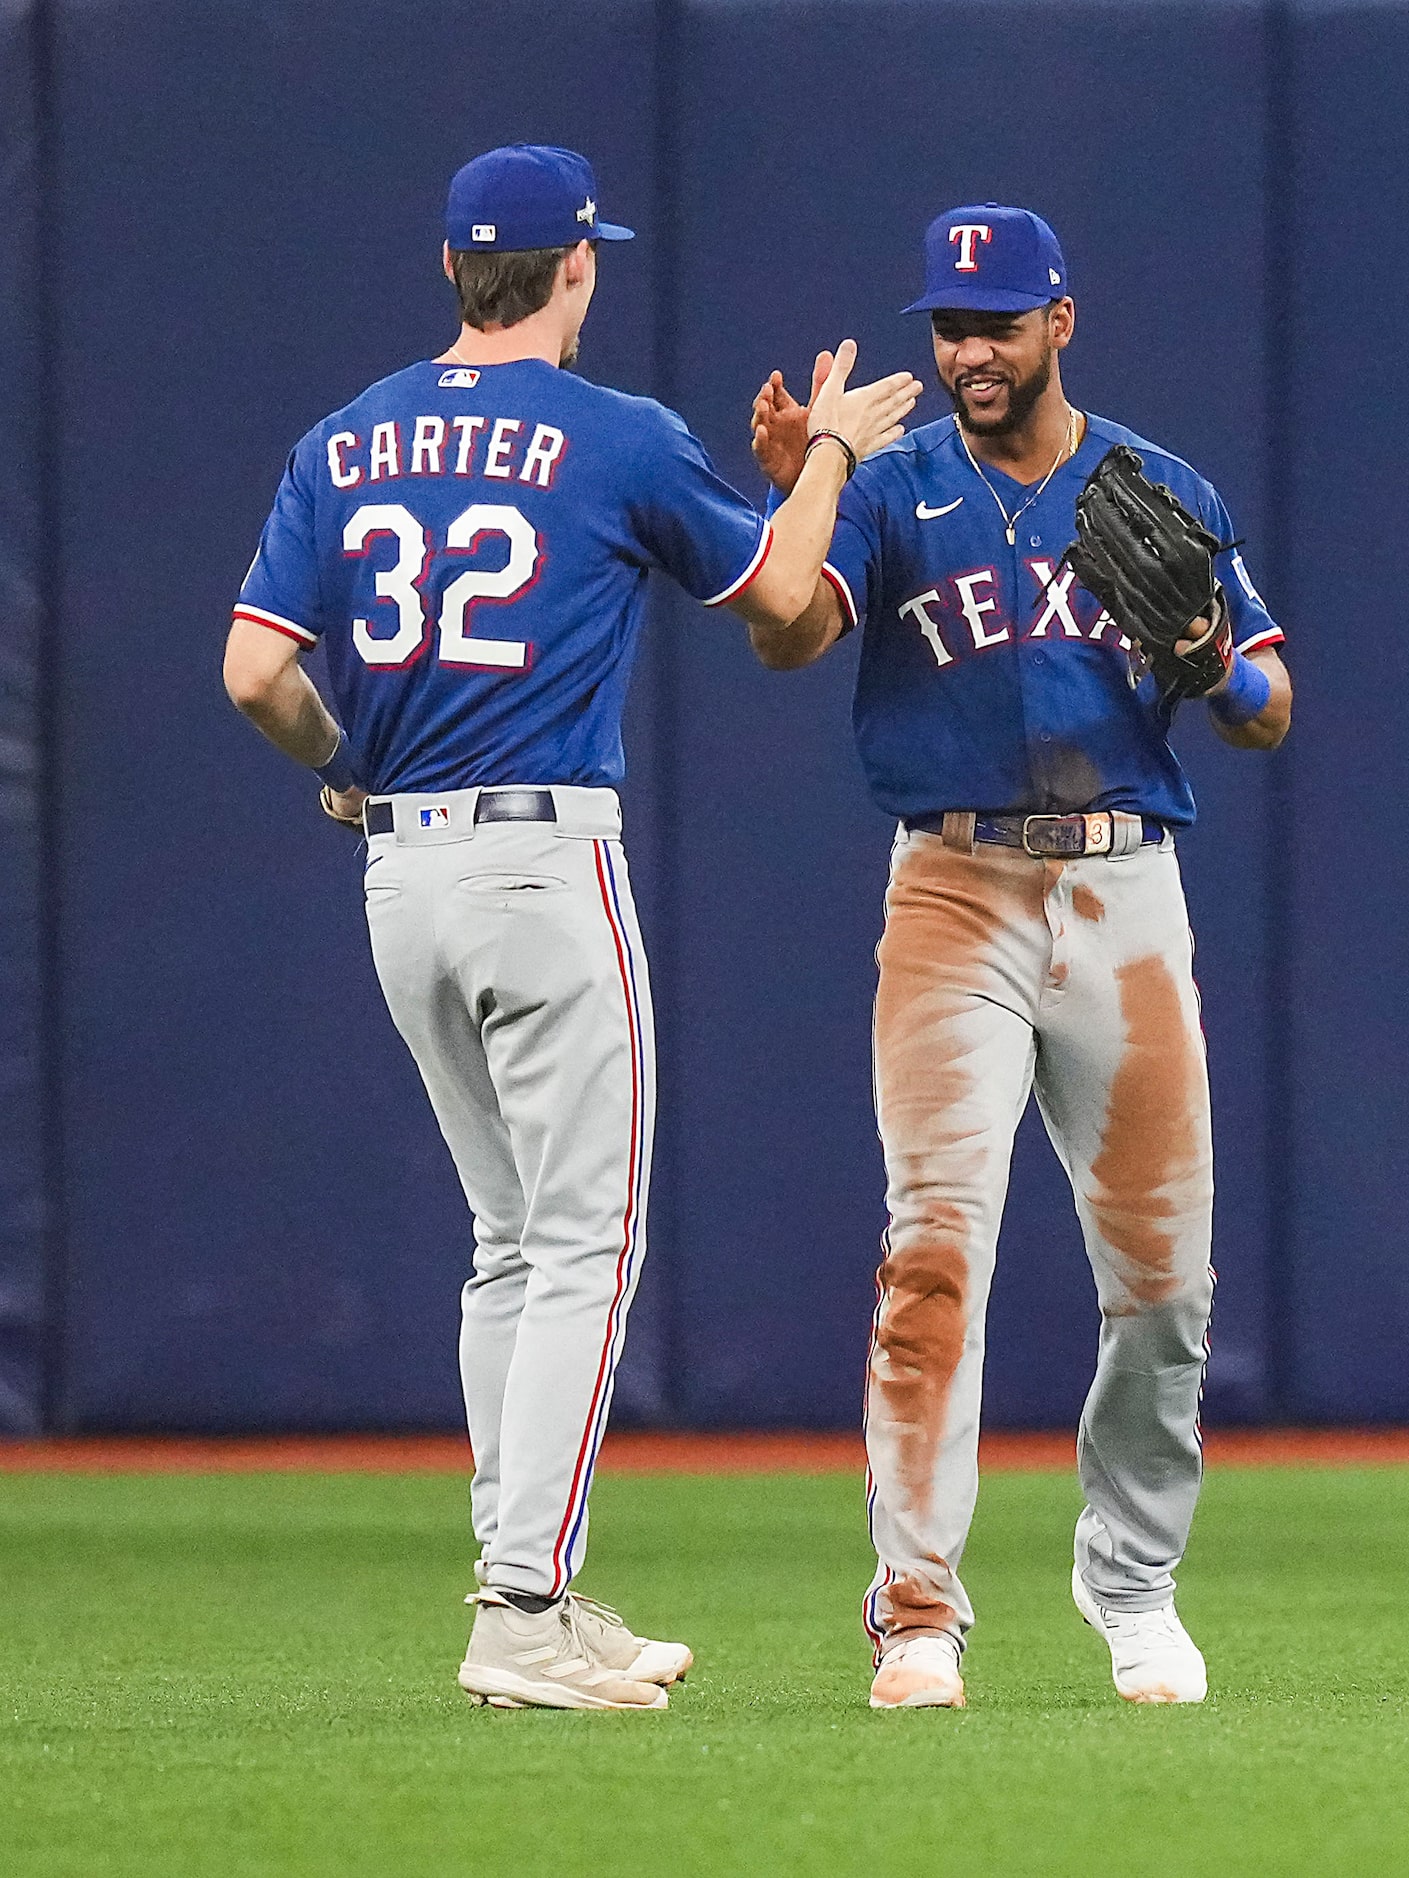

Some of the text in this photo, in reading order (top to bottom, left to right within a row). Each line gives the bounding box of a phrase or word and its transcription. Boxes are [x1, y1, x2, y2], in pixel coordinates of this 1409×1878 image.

[948, 224, 993, 273] T
[327, 414, 568, 491] CARTER
[342, 502, 546, 675] 32
